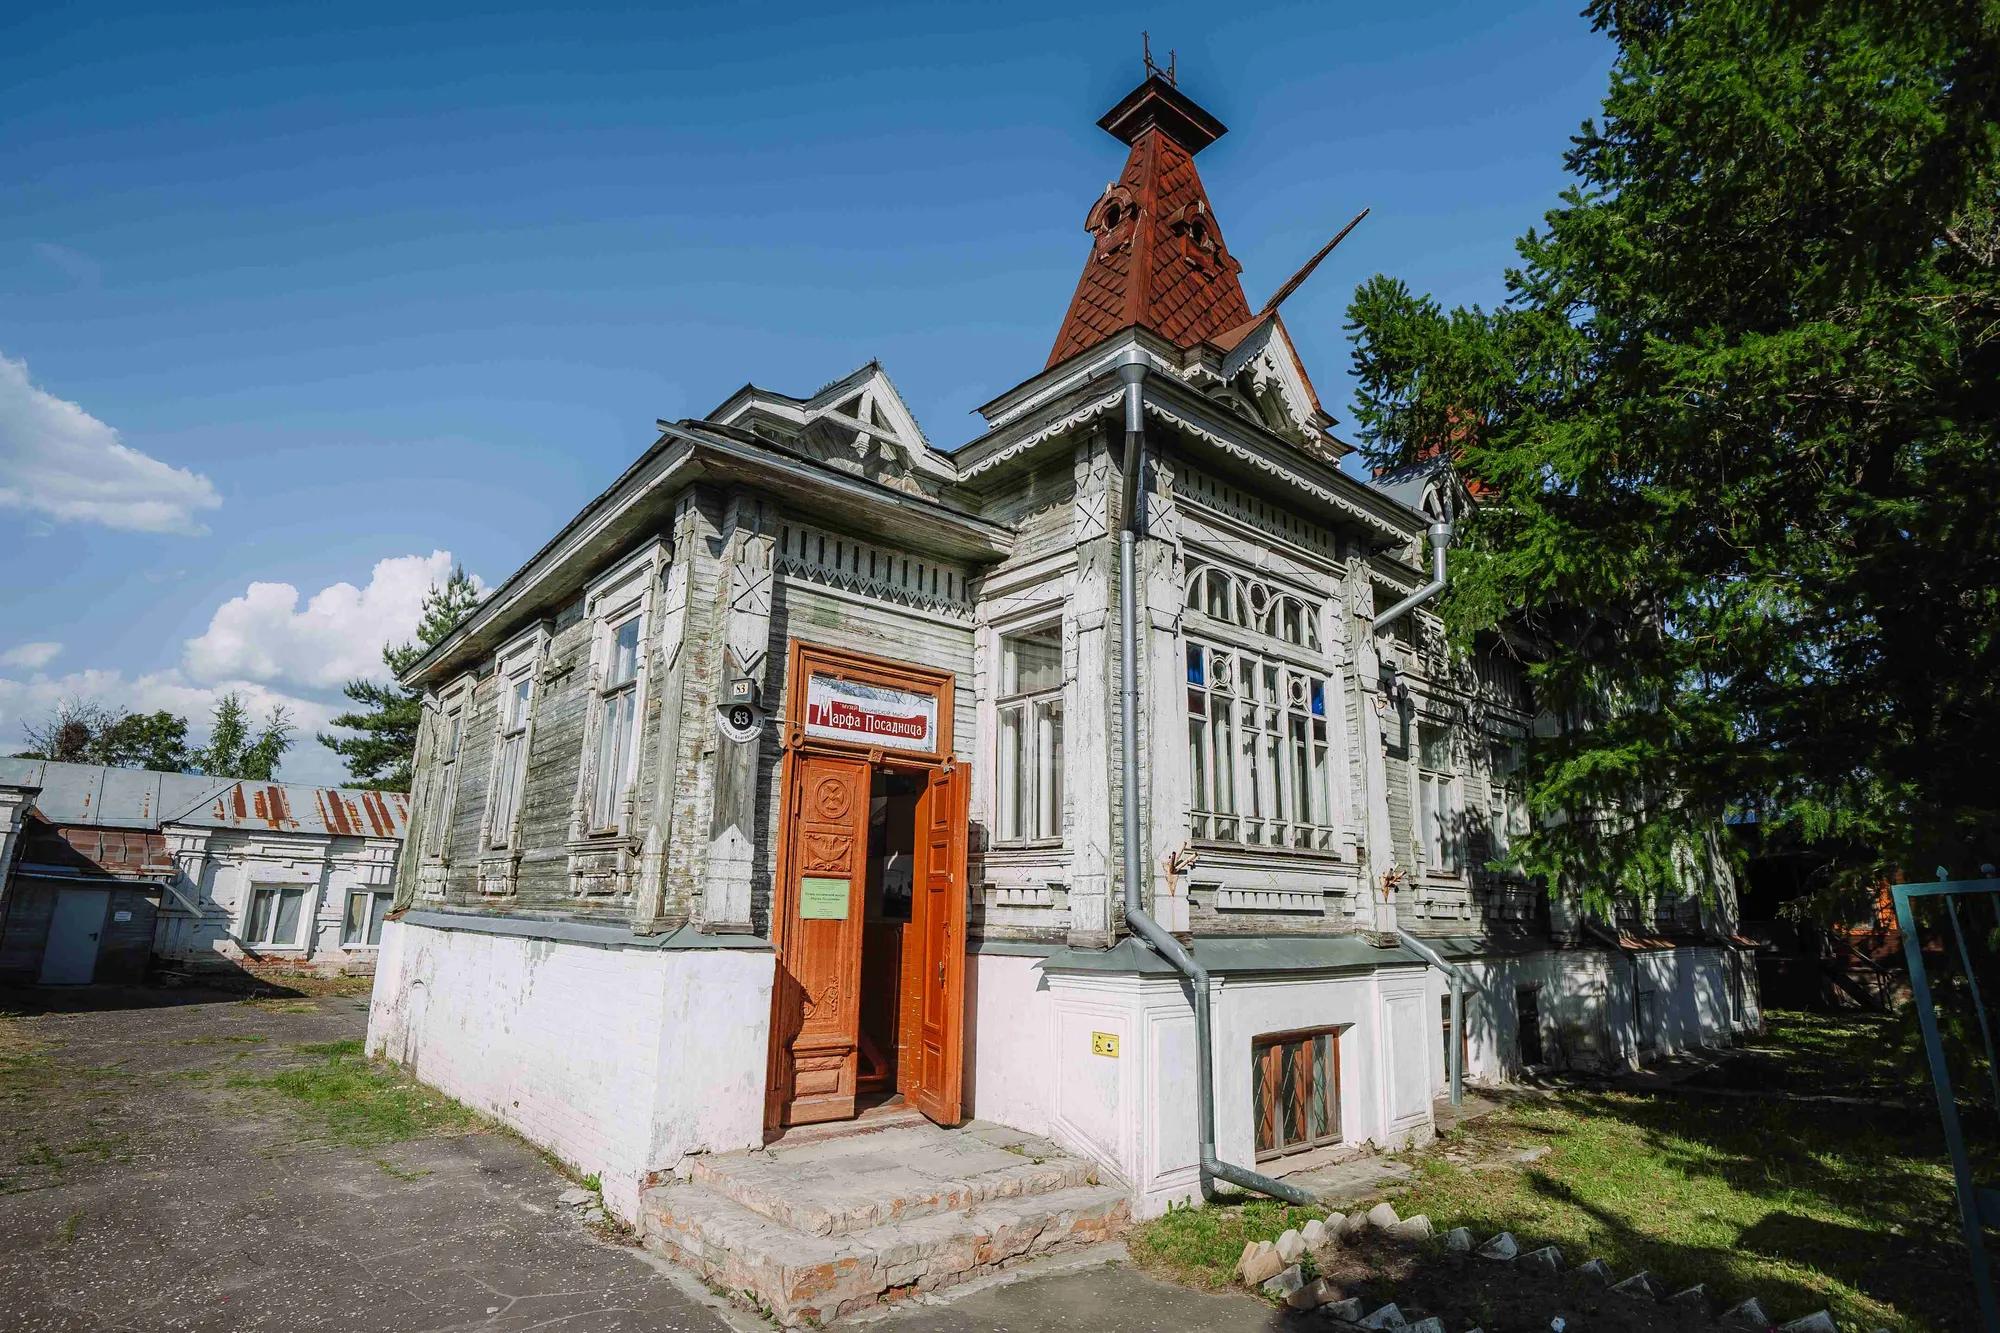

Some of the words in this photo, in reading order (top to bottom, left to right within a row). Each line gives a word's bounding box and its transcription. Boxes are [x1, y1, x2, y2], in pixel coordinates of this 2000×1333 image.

[733, 710, 749, 725] 83
[816, 694, 861, 729] Марфа
[865, 714, 923, 737] Посадница
